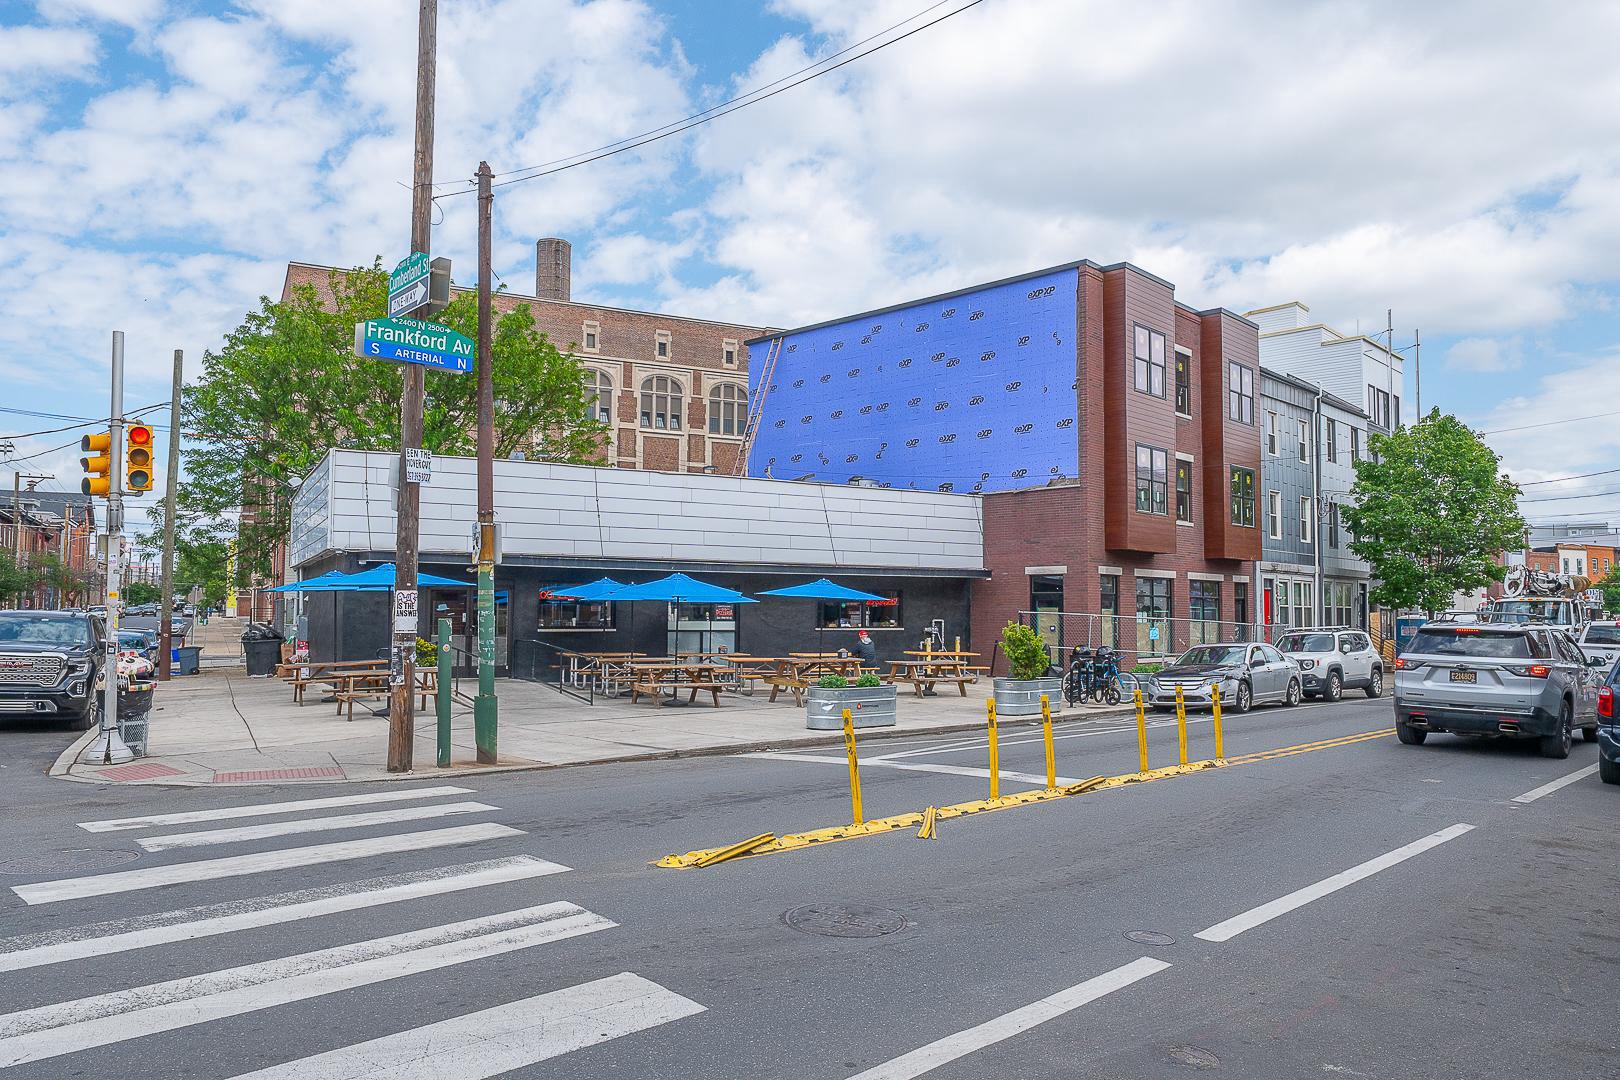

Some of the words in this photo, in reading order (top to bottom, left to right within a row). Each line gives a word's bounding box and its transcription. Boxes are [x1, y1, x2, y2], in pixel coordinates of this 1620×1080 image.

[390, 260, 421, 292] Cumberland
[422, 258, 429, 272] St
[1028, 289, 1044, 299] eXP
[942, 308, 956, 318] eXP
[398, 318, 416, 328] 2400
[418, 322, 426, 330] N
[428, 324, 444, 332] 2500
[368, 321, 446, 350] Frankford
[452, 340, 472, 355] Av
[371, 342, 380, 354] S
[395, 348, 444, 365] ARTERIAL
[457, 358, 467, 370] N
[932, 352, 946, 362] eXP
[898, 358, 912, 368] eXP
[848, 368, 860, 377] eXP
[792, 380, 804, 388] eXP
[1006, 381, 1022, 390] eXP
[876, 402, 889, 410] eXP
[908, 398, 922, 406] eXP
[860, 406, 872, 414] eXP
[775, 420, 786, 428] eXP
[801, 416, 813, 424] eXP
[1056, 418, 1073, 428] eXP
[977, 429, 992, 438] eXP
[906, 438, 920, 447] eXP
[420, 450, 431, 460] THE
[1011, 468, 1028, 478] eXP
